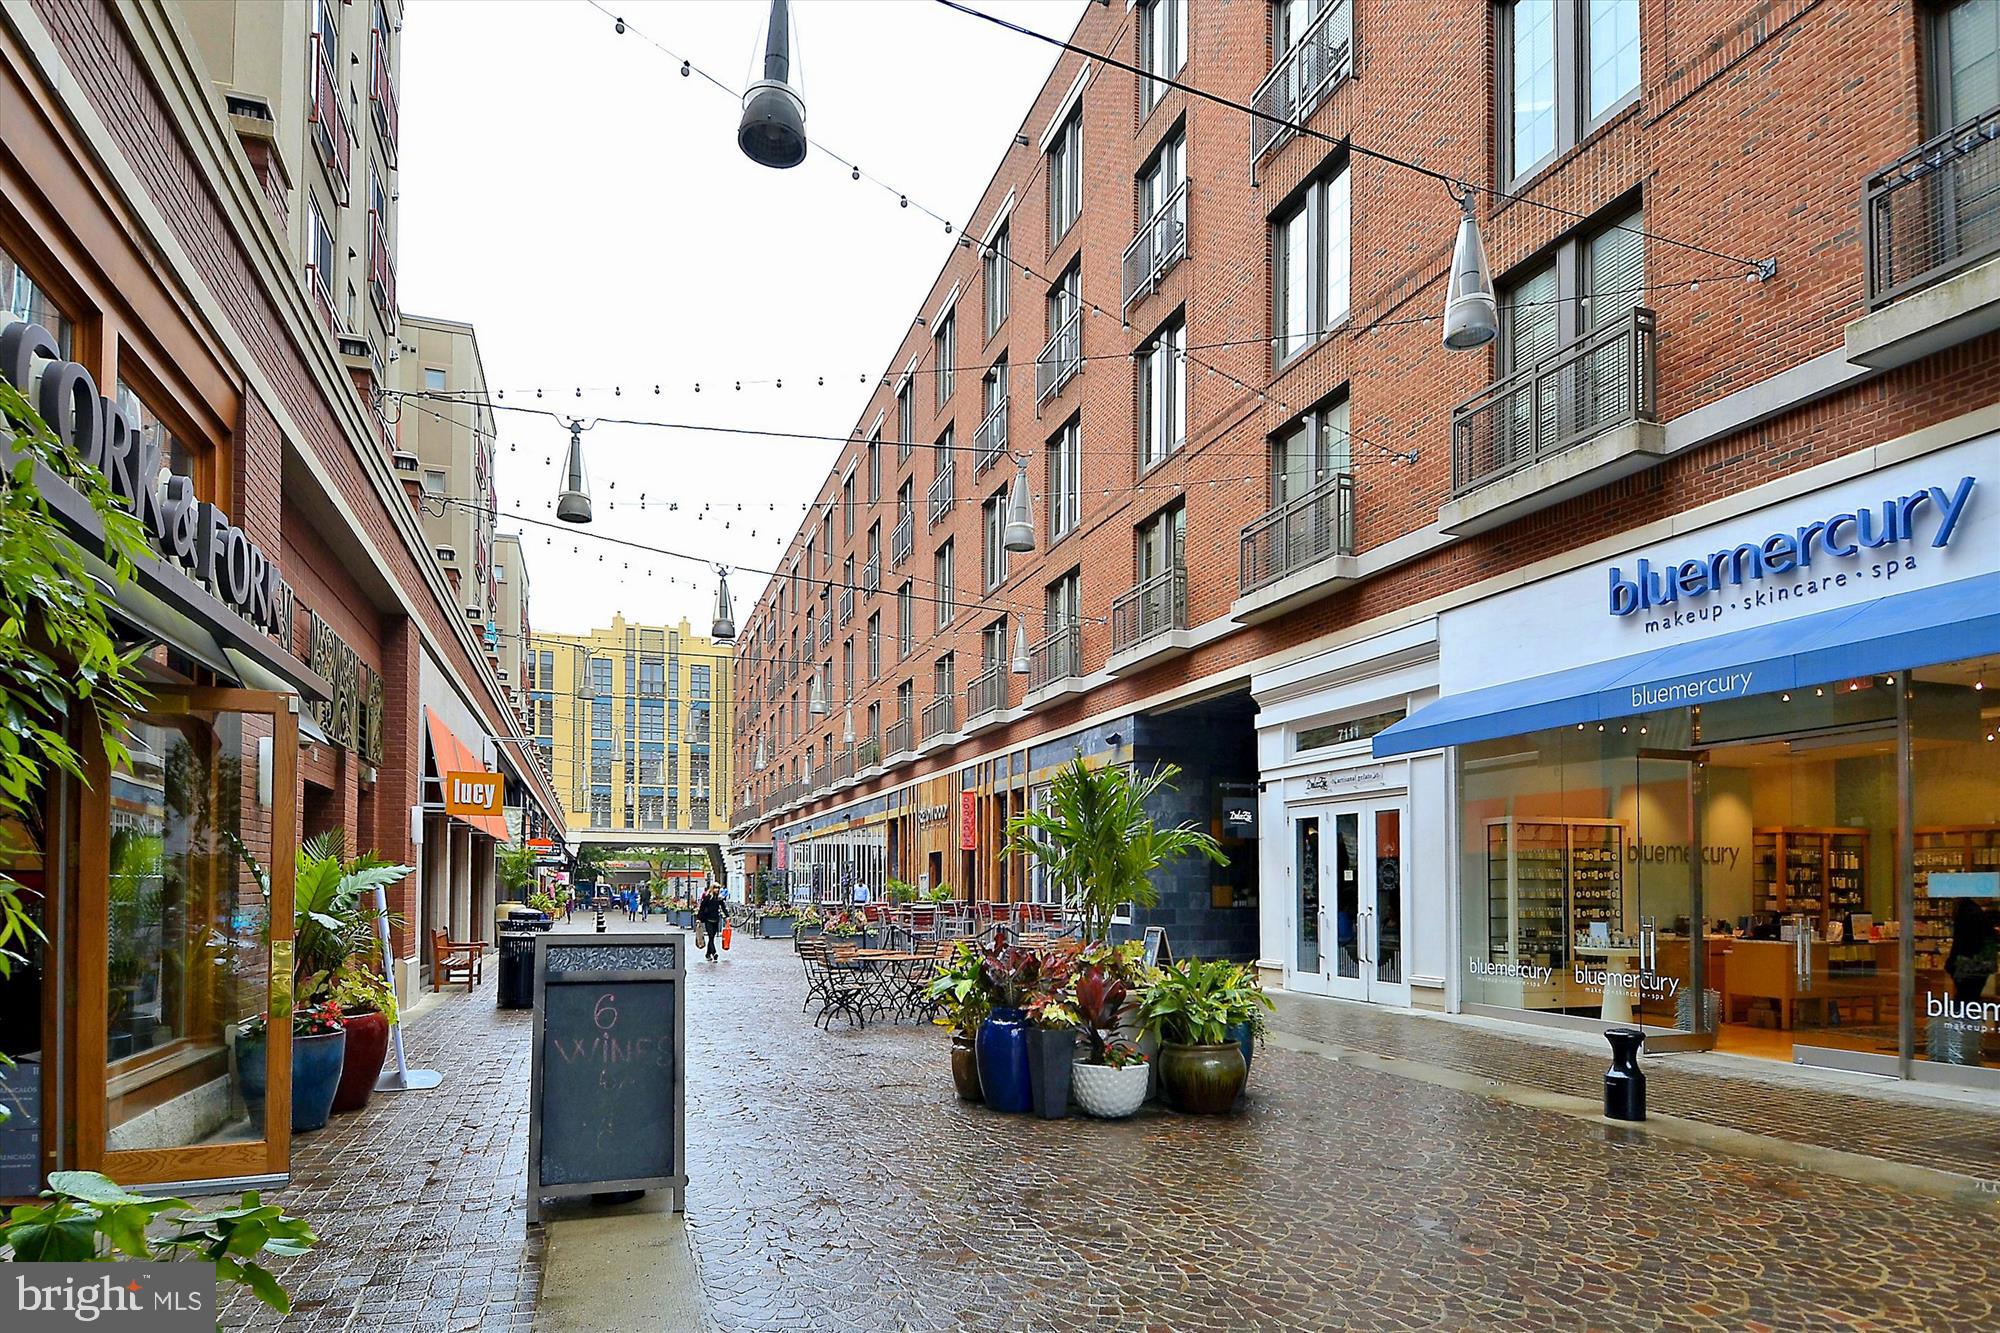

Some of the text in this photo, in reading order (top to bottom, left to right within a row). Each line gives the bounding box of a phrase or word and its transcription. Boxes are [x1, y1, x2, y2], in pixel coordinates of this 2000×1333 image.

[160, 474, 199, 568] &
[198, 502, 284, 634] FORK
[1608, 476, 1976, 617] bluemercury
[1644, 554, 1917, 633] makeup skincare spa
[1631, 671, 1753, 708] bluemercury
[1338, 725, 1359, 741] 7111
[453, 778, 496, 809] lucy
[1626, 837, 1739, 871] bluemecury
[1469, 957, 1552, 984] bluemercury
[1575, 964, 1680, 997] bluemercury
[594, 993, 618, 1030] 6
[1943, 1021, 1988, 1033] makeup
